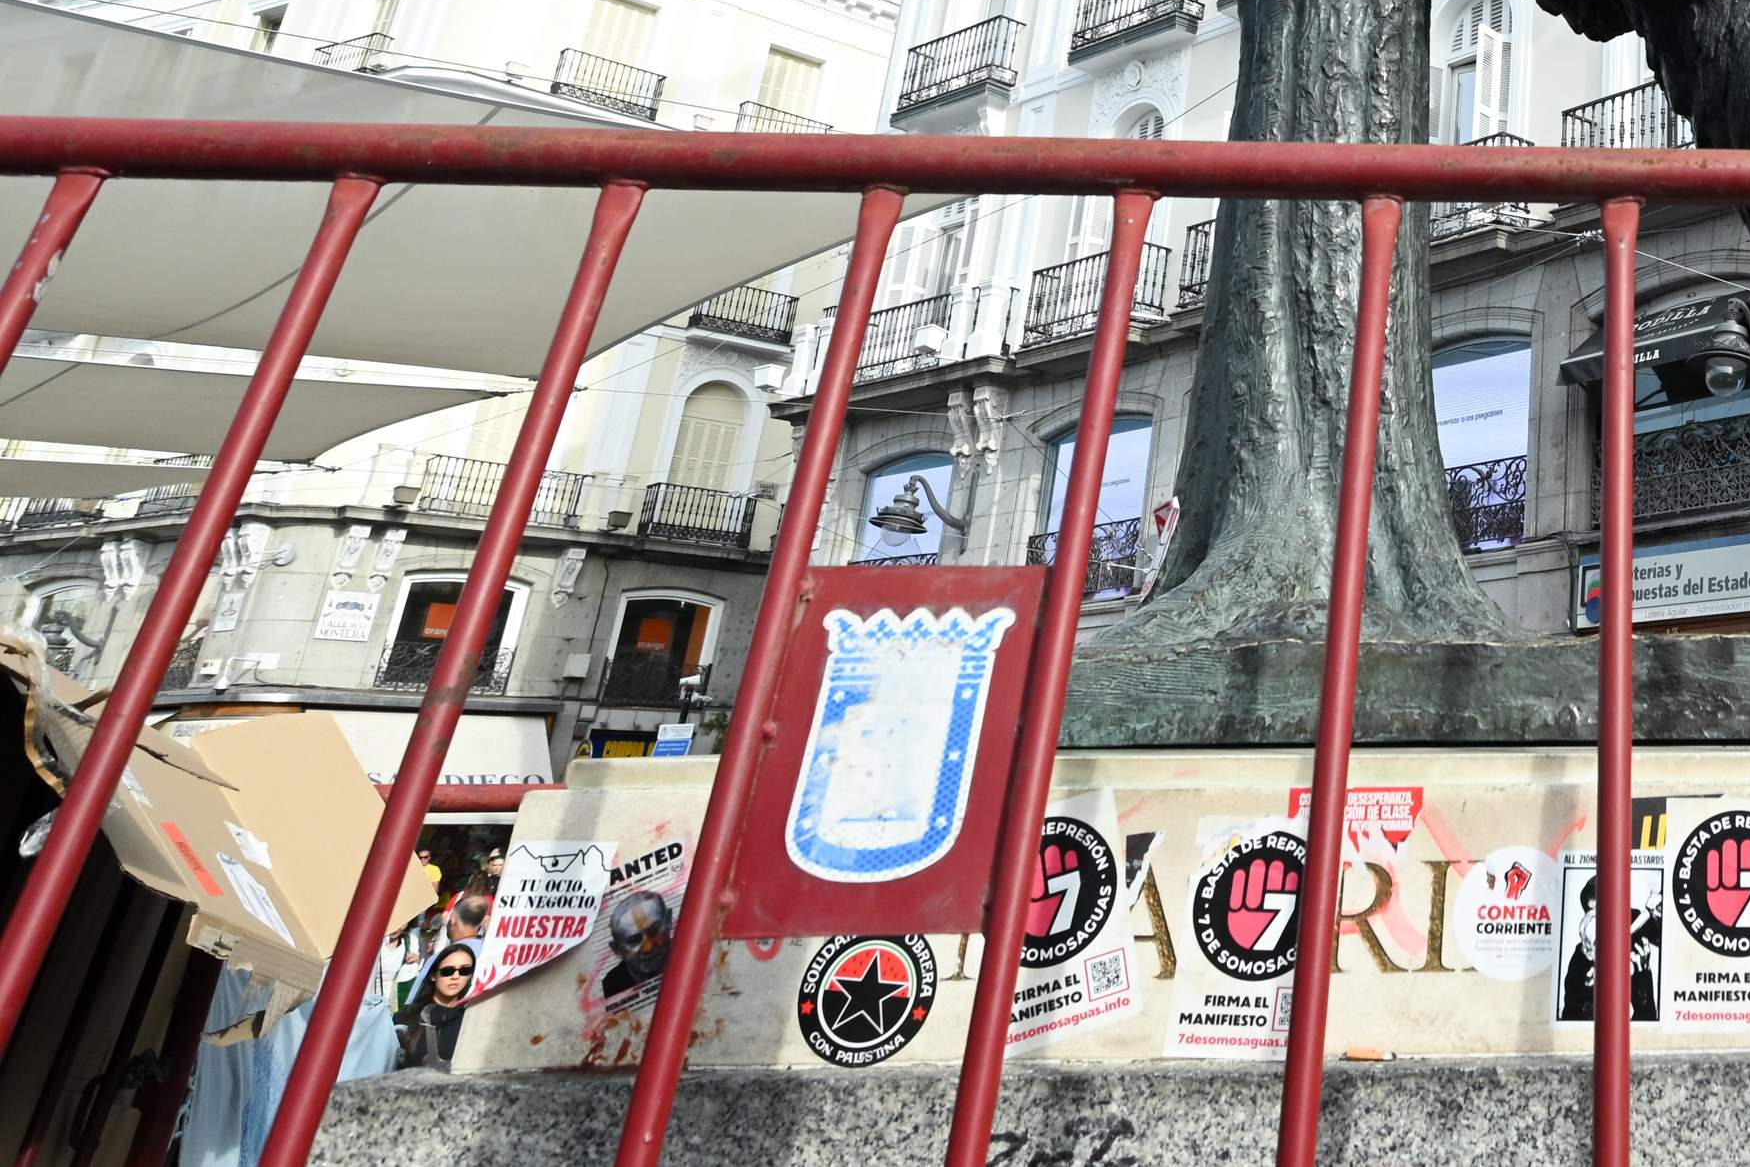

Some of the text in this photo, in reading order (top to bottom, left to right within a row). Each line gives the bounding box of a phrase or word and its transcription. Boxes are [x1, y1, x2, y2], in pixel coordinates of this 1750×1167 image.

[1634, 349, 1660, 363] ILLA
[1438, 417, 1460, 427] nvenido
[1632, 562, 1684, 581] terías y
[1632, 582, 1679, 602] uestas
[1683, 577, 1704, 596] del
[1564, 853, 1576, 864] ALL
[1579, 854, 1597, 865] ZION
[1679, 830, 1711, 880] BASTA
[1710, 815, 1732, 835] DE
[609, 842, 683, 887] ANTED
[1201, 849, 1240, 900] BASTA
[1241, 837, 1264, 855] DE
[520, 879, 587, 894] TU OCIO,
[498, 895, 598, 911] SU NEGOCIO,
[1477, 905, 1551, 921] CONTRA
[496, 915, 588, 939] NUESTRA
[1020, 884, 1112, 962] SOMOSAGUAS
[1476, 922, 1552, 935] CORRIENTE
[1683, 909, 1705, 934] DE
[1201, 930, 1221, 955] DE
[1217, 946, 1297, 976] SOMOSAG
[803, 934, 933, 998] SOLIDA OBRERA
[1013, 972, 1081, 1006] FIRMA EL
[1695, 972, 1741, 985] FIRMA
[1009, 991, 1082, 1024] ANIFIESTO
[1204, 994, 1269, 1009] FIRMA EL
[1006, 996, 1130, 1046] desomosaguas.info
[1179, 1012, 1267, 1028] MANIFIESTO
[809, 1031, 905, 1064] CON PALESTINA
